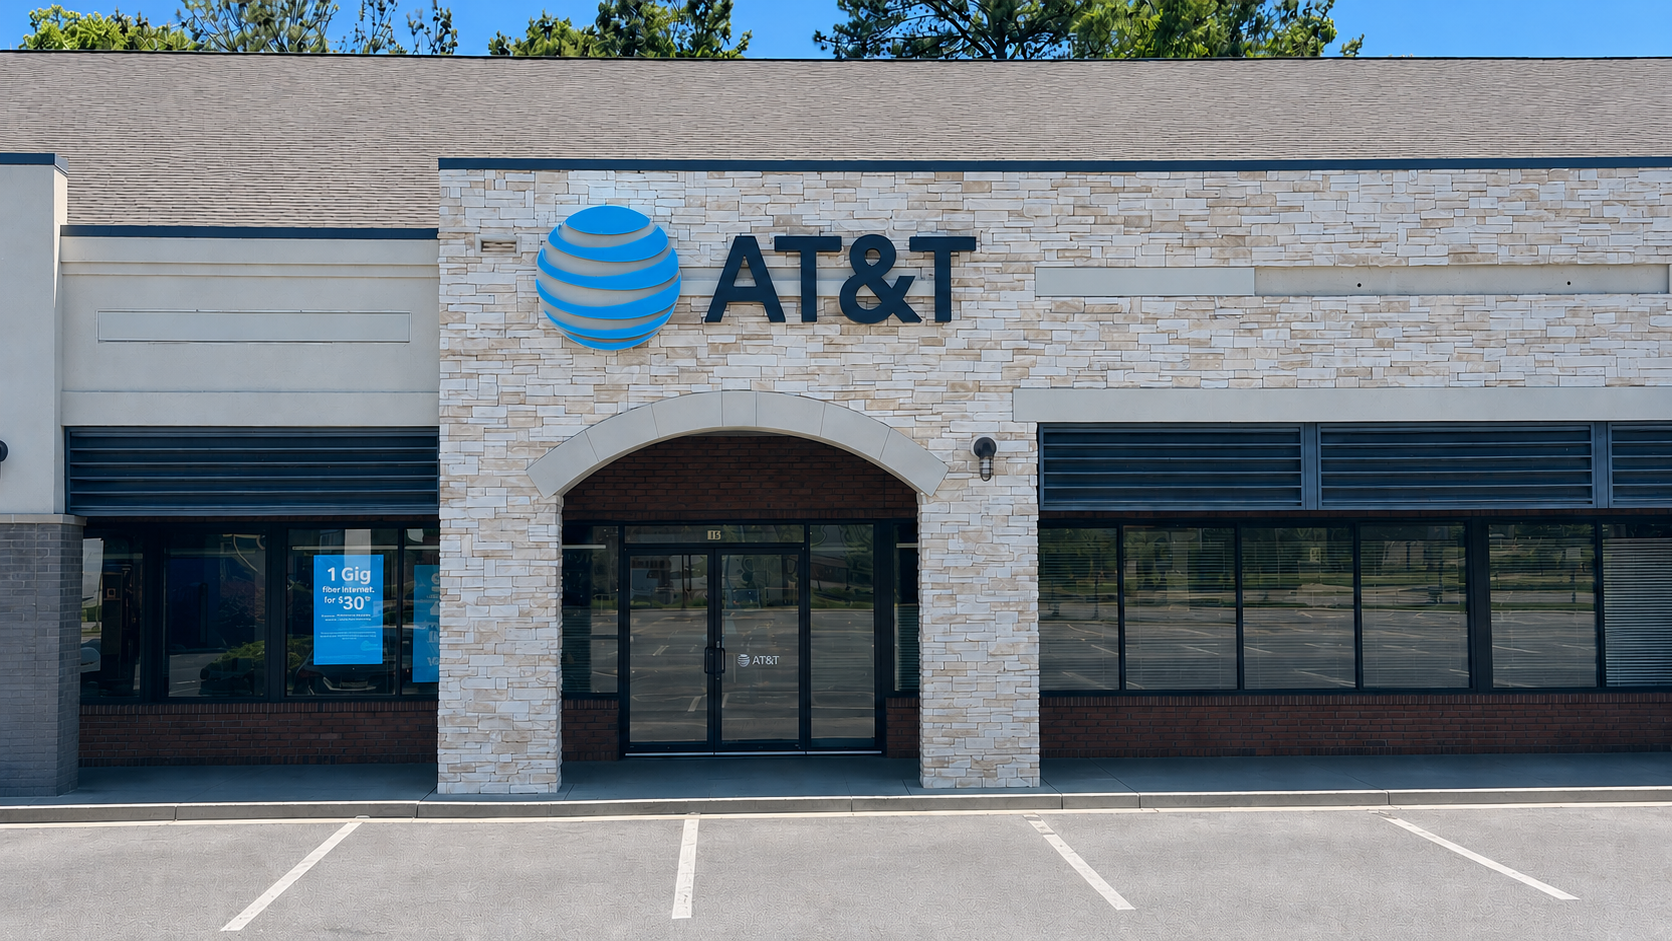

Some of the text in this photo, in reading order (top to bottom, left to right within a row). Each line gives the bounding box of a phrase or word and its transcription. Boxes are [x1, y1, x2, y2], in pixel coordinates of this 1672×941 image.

[704, 233, 976, 324] AT&T
[327, 566, 371, 584] 1 Gig
[322, 585, 341, 593] fiber
[338, 596, 371, 610] $30
[752, 655, 780, 665] AT&T
